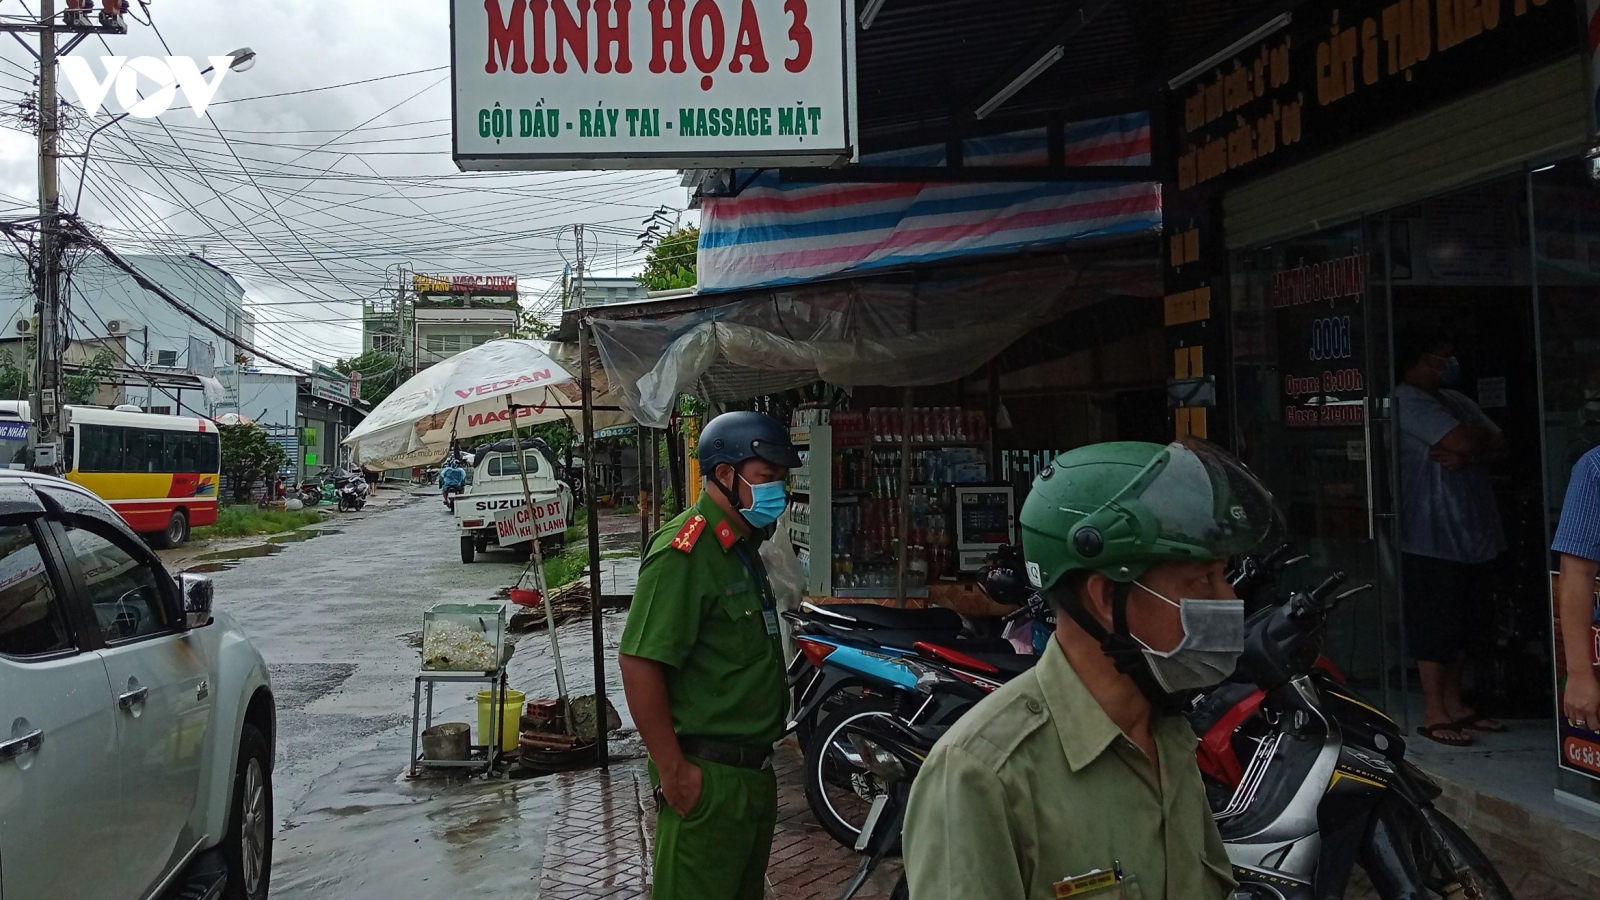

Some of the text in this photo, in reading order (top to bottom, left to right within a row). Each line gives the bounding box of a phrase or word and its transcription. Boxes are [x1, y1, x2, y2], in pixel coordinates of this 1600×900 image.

[484, 0, 814, 91] MINH HỌA 3
[478, 101, 513, 145] GỘI
[519, 97, 560, 138] DẦU
[579, 100, 619, 138] RÁY
[625, 108, 660, 137] TAI
[679, 107, 772, 137] MASSAGE
[778, 100, 821, 143] MẶT
[485, 275, 515, 291] DUNG
[455, 369, 552, 399] VEDAN
[7, 425, 28, 438] NHÂN
[516, 501, 561, 524] CARD ĐT
[498, 516, 514, 538] BÁN
[520, 518, 565, 537] KHN LẠNH
